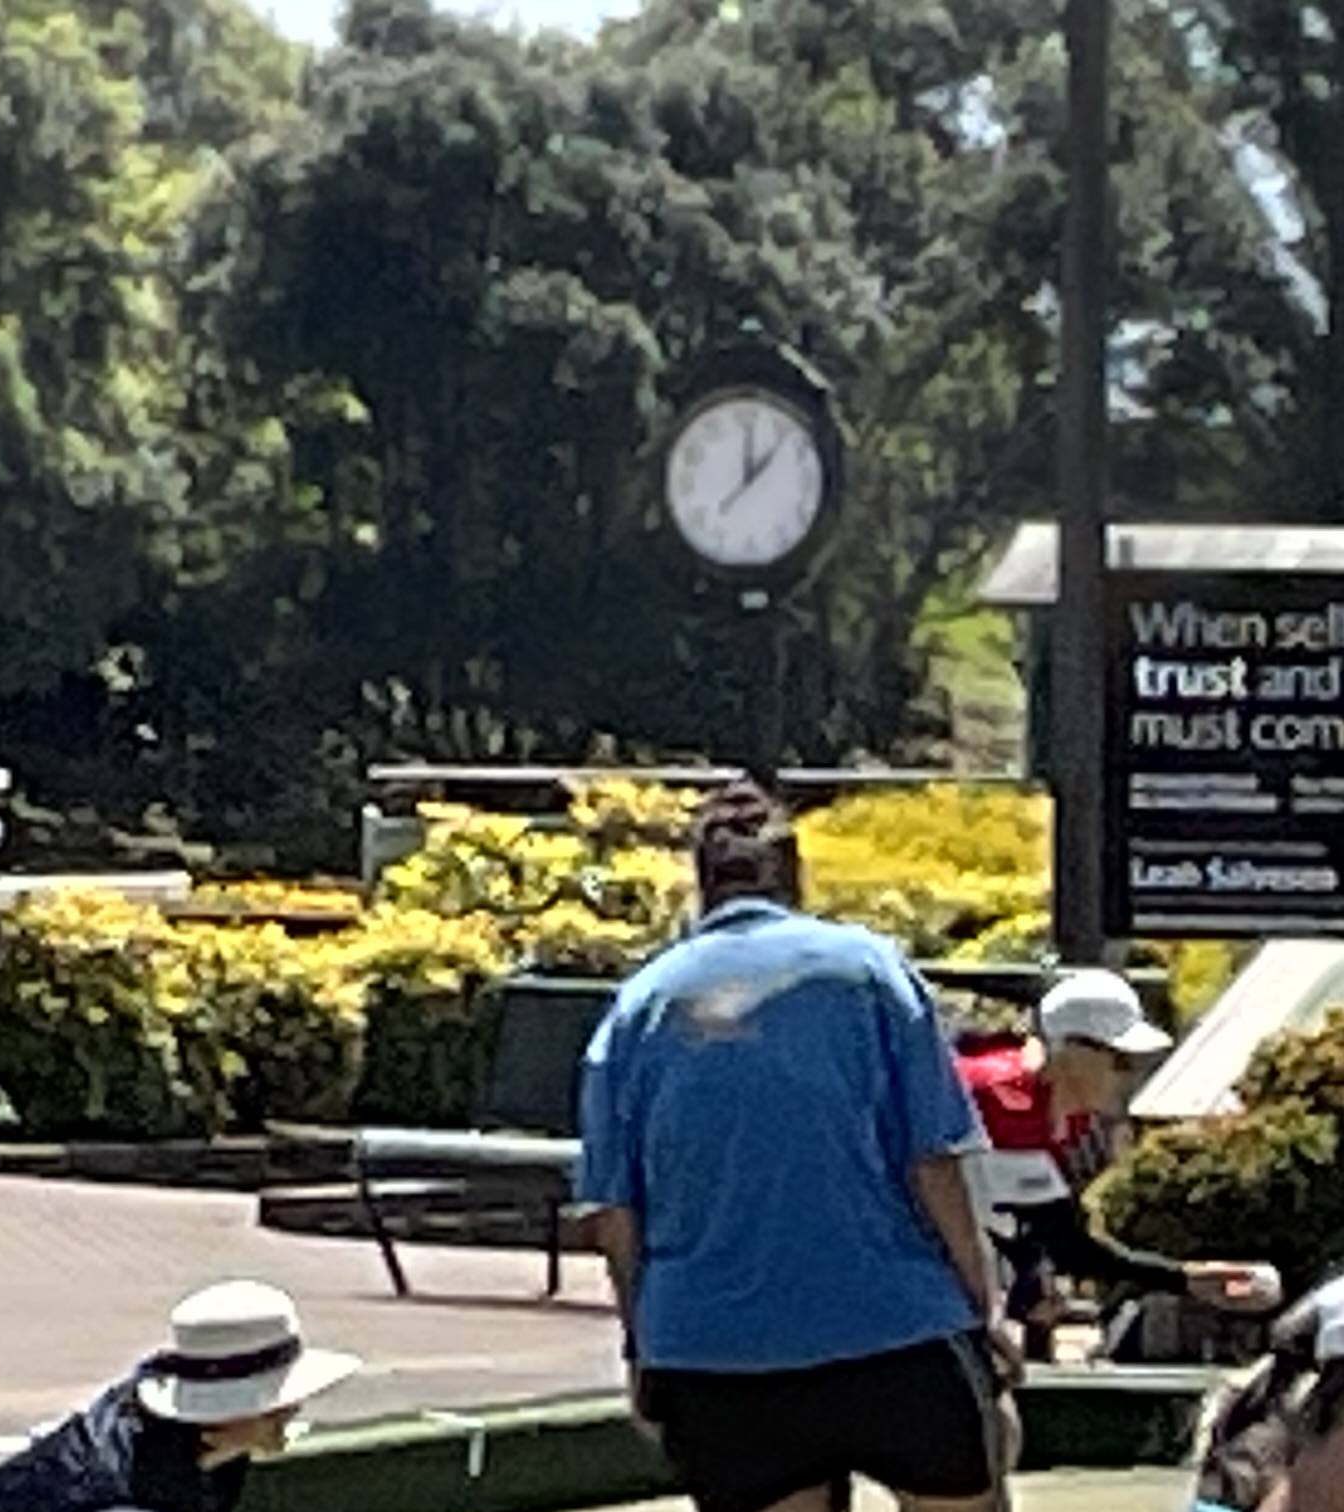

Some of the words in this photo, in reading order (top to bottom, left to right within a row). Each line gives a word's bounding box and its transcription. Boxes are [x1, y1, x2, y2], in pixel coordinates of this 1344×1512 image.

[1130, 602, 1267, 648] When
[1134, 656, 1247, 697] trust
[1258, 656, 1340, 699] and
[1131, 708, 1241, 749] must
